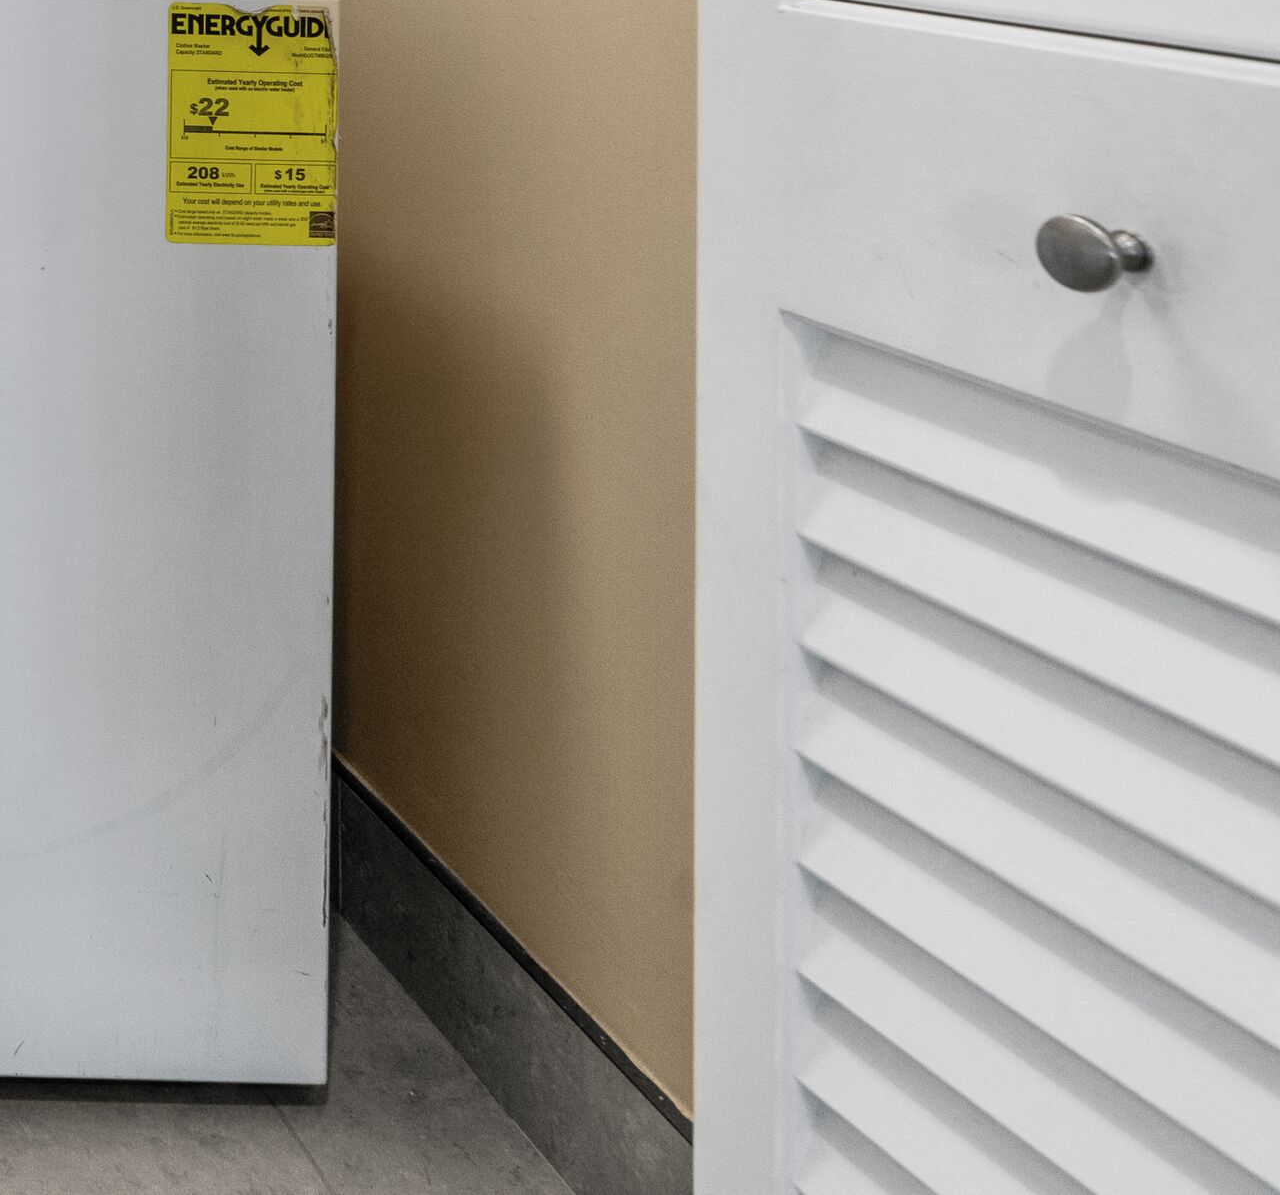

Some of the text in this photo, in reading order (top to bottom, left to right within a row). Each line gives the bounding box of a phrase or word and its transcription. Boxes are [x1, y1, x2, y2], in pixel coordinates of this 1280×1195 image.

[207, 78, 237, 86] Estimated
[239, 79, 257, 87] Yearly
[187, 166, 220, 180] 208
[221, 198, 242, 207] depend
[266, 199, 282, 207] utility
